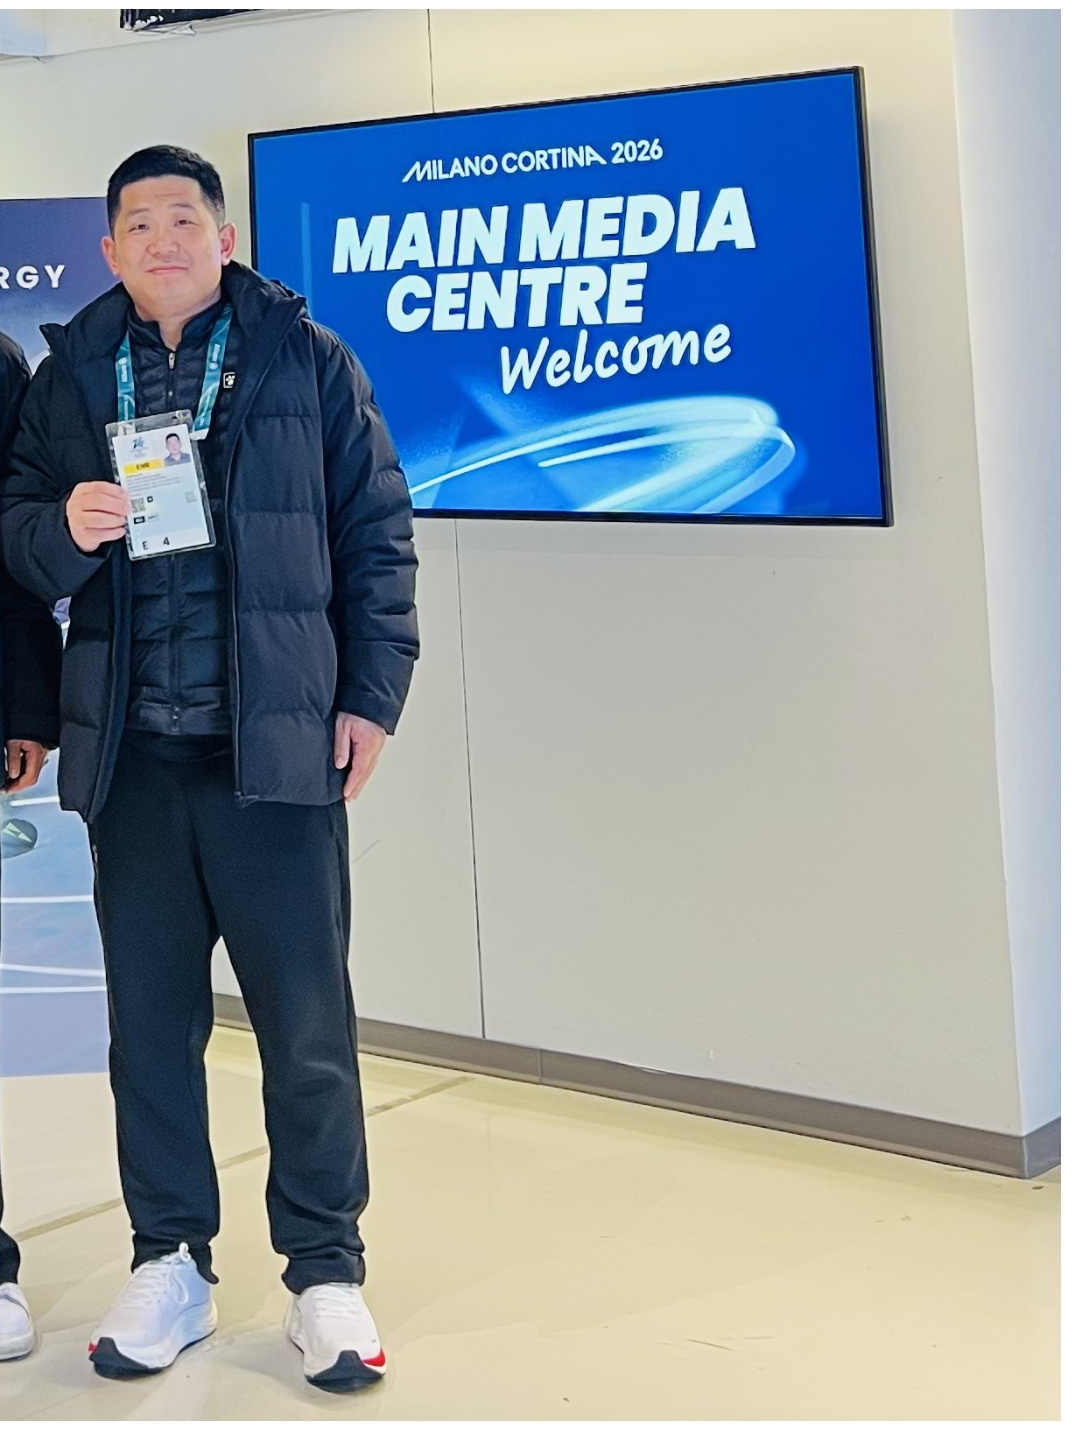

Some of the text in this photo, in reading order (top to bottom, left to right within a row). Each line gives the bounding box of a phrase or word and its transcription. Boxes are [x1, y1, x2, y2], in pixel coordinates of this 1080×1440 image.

[402, 138, 663, 183] MILANO CORTINA 2026
[332, 187, 756, 274] MAIN MEDIA
[386, 262, 648, 332] CENTRE
[501, 323, 732, 395] Welcome
[142, 536, 171, 550] E 4
